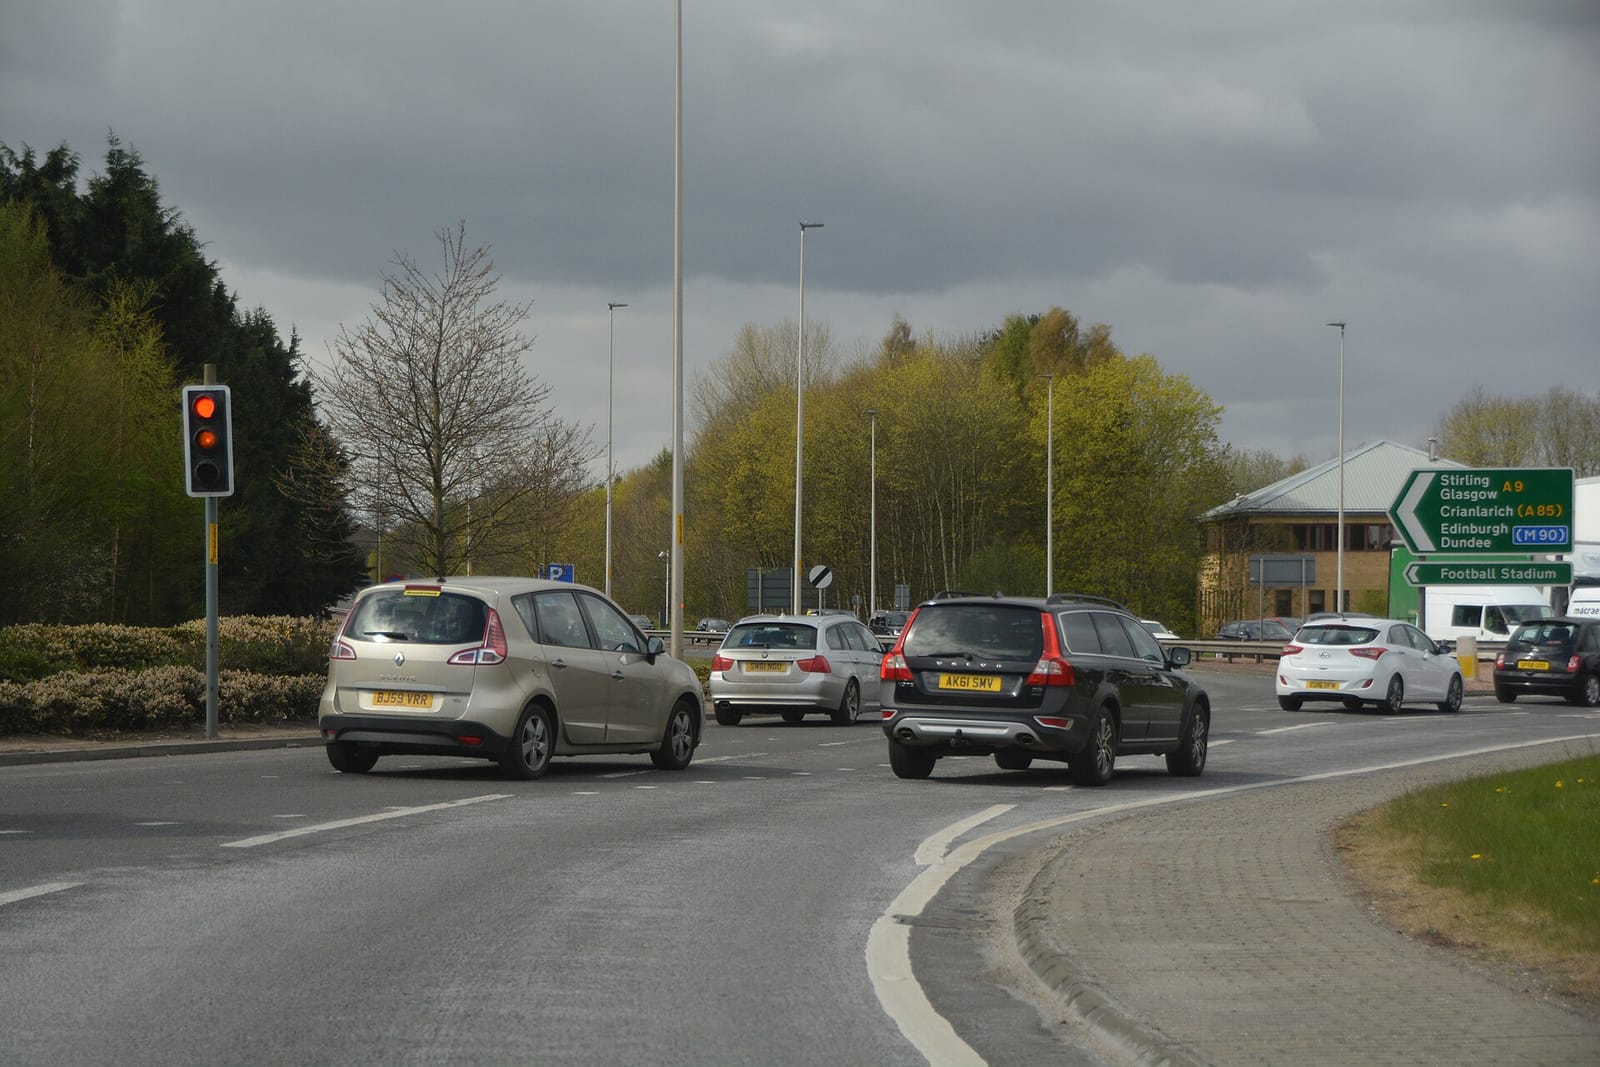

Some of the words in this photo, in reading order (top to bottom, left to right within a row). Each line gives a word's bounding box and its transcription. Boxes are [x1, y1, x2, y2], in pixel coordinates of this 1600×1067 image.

[1440, 474, 1489, 488] Stirling
[1502, 480, 1524, 493] A9
[1440, 488, 1498, 501] Glasgow
[1440, 505, 1514, 518] Crianlarich
[1517, 503, 1563, 518] (A85)
[1440, 522, 1509, 536] Edinburgh
[1515, 528, 1565, 543] (M90)
[1440, 536, 1492, 548] Dundee
[1440, 567, 1496, 580] Football
[1500, 567, 1557, 580] Stadium
[945, 675, 970, 687] AK61
[972, 677, 994, 688] SMV
[376, 692, 404, 705] BJ59
[406, 693, 428, 706] VRR
